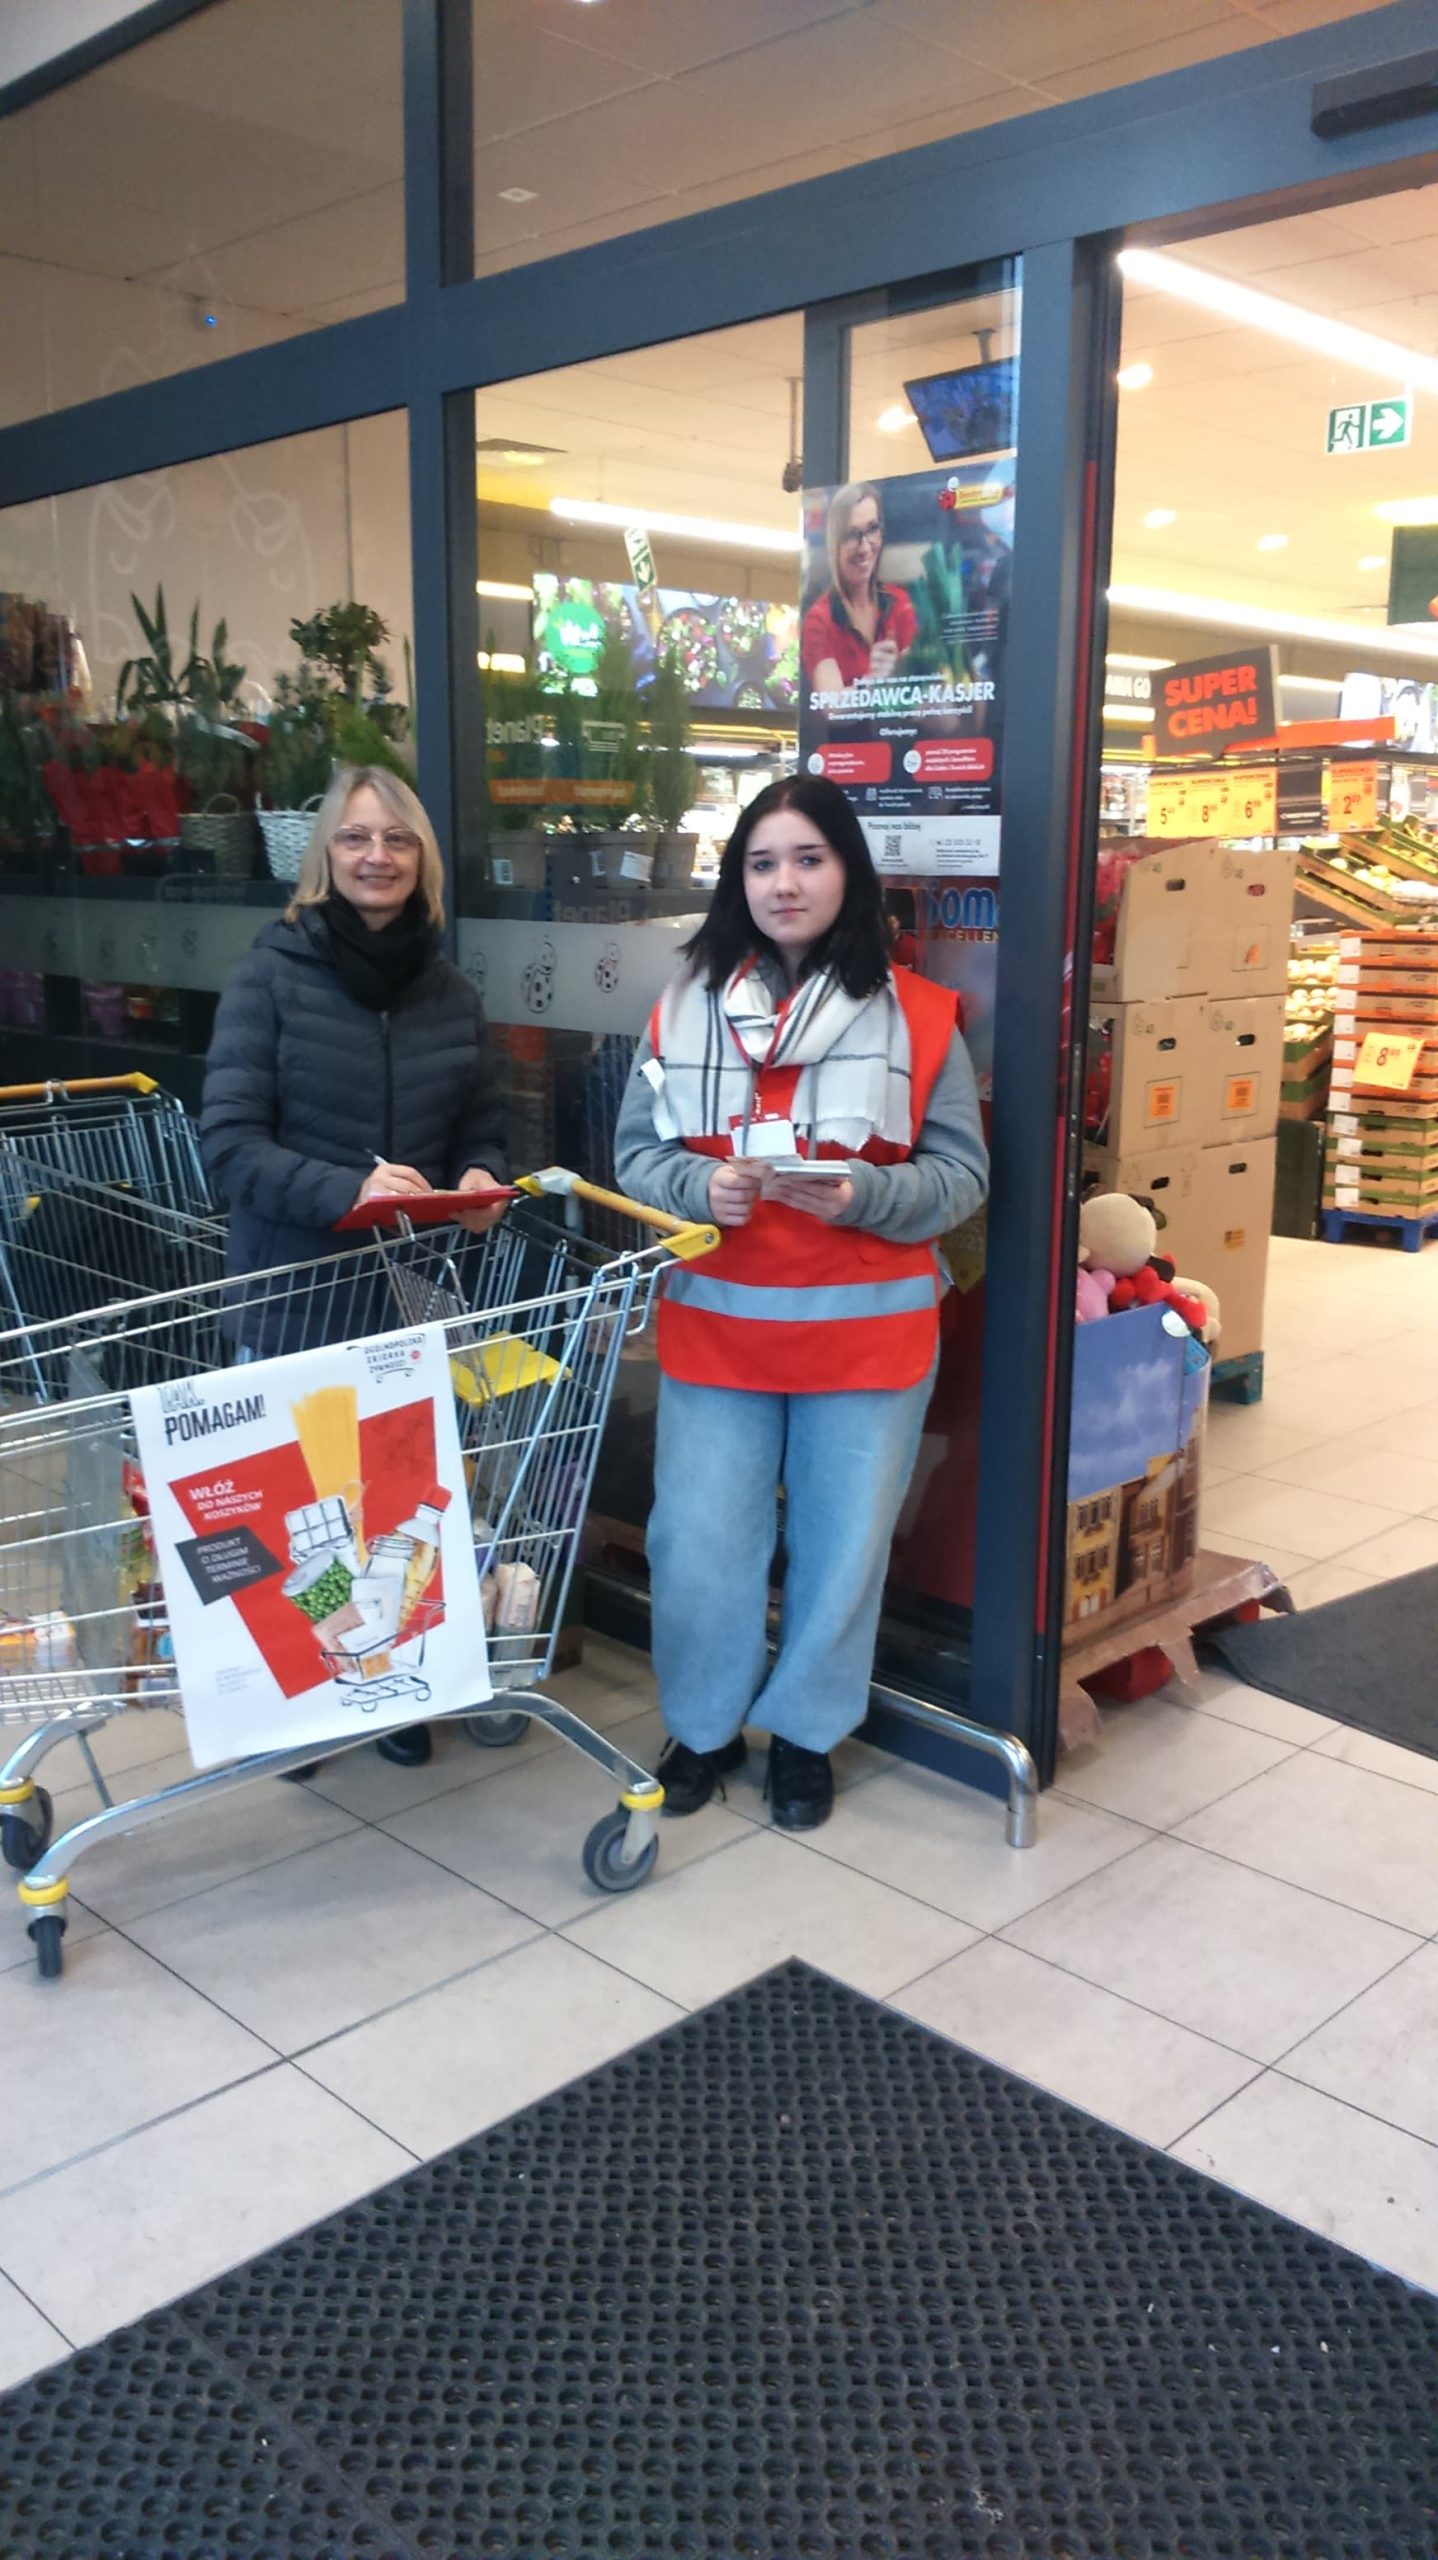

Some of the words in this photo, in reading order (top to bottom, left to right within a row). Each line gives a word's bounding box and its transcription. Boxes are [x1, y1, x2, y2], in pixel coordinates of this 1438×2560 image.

[809, 681, 996, 710] SPRZEDAWCA-KASJER
[1164, 665, 1257, 707] SUPER
[1168, 697, 1257, 738] CENA!
[1376, 1047, 1389, 1066] 8
[164, 1394, 267, 1446] POMAGAM!
[189, 1479, 236, 1500] WŁÓŻ
[197, 1500, 214, 1511] DO
[215, 1489, 264, 1507] NASZYCH
[204, 1501, 262, 1520] KOSZYKÓW
[196, 1537, 240, 1554] PRODUKT
[201, 1555, 210, 1565] O
[211, 1546, 249, 1562] DŁUGIM
[206, 1557, 248, 1574] TERMINIE
[212, 1564, 262, 1583] WAŻNOŚCI
